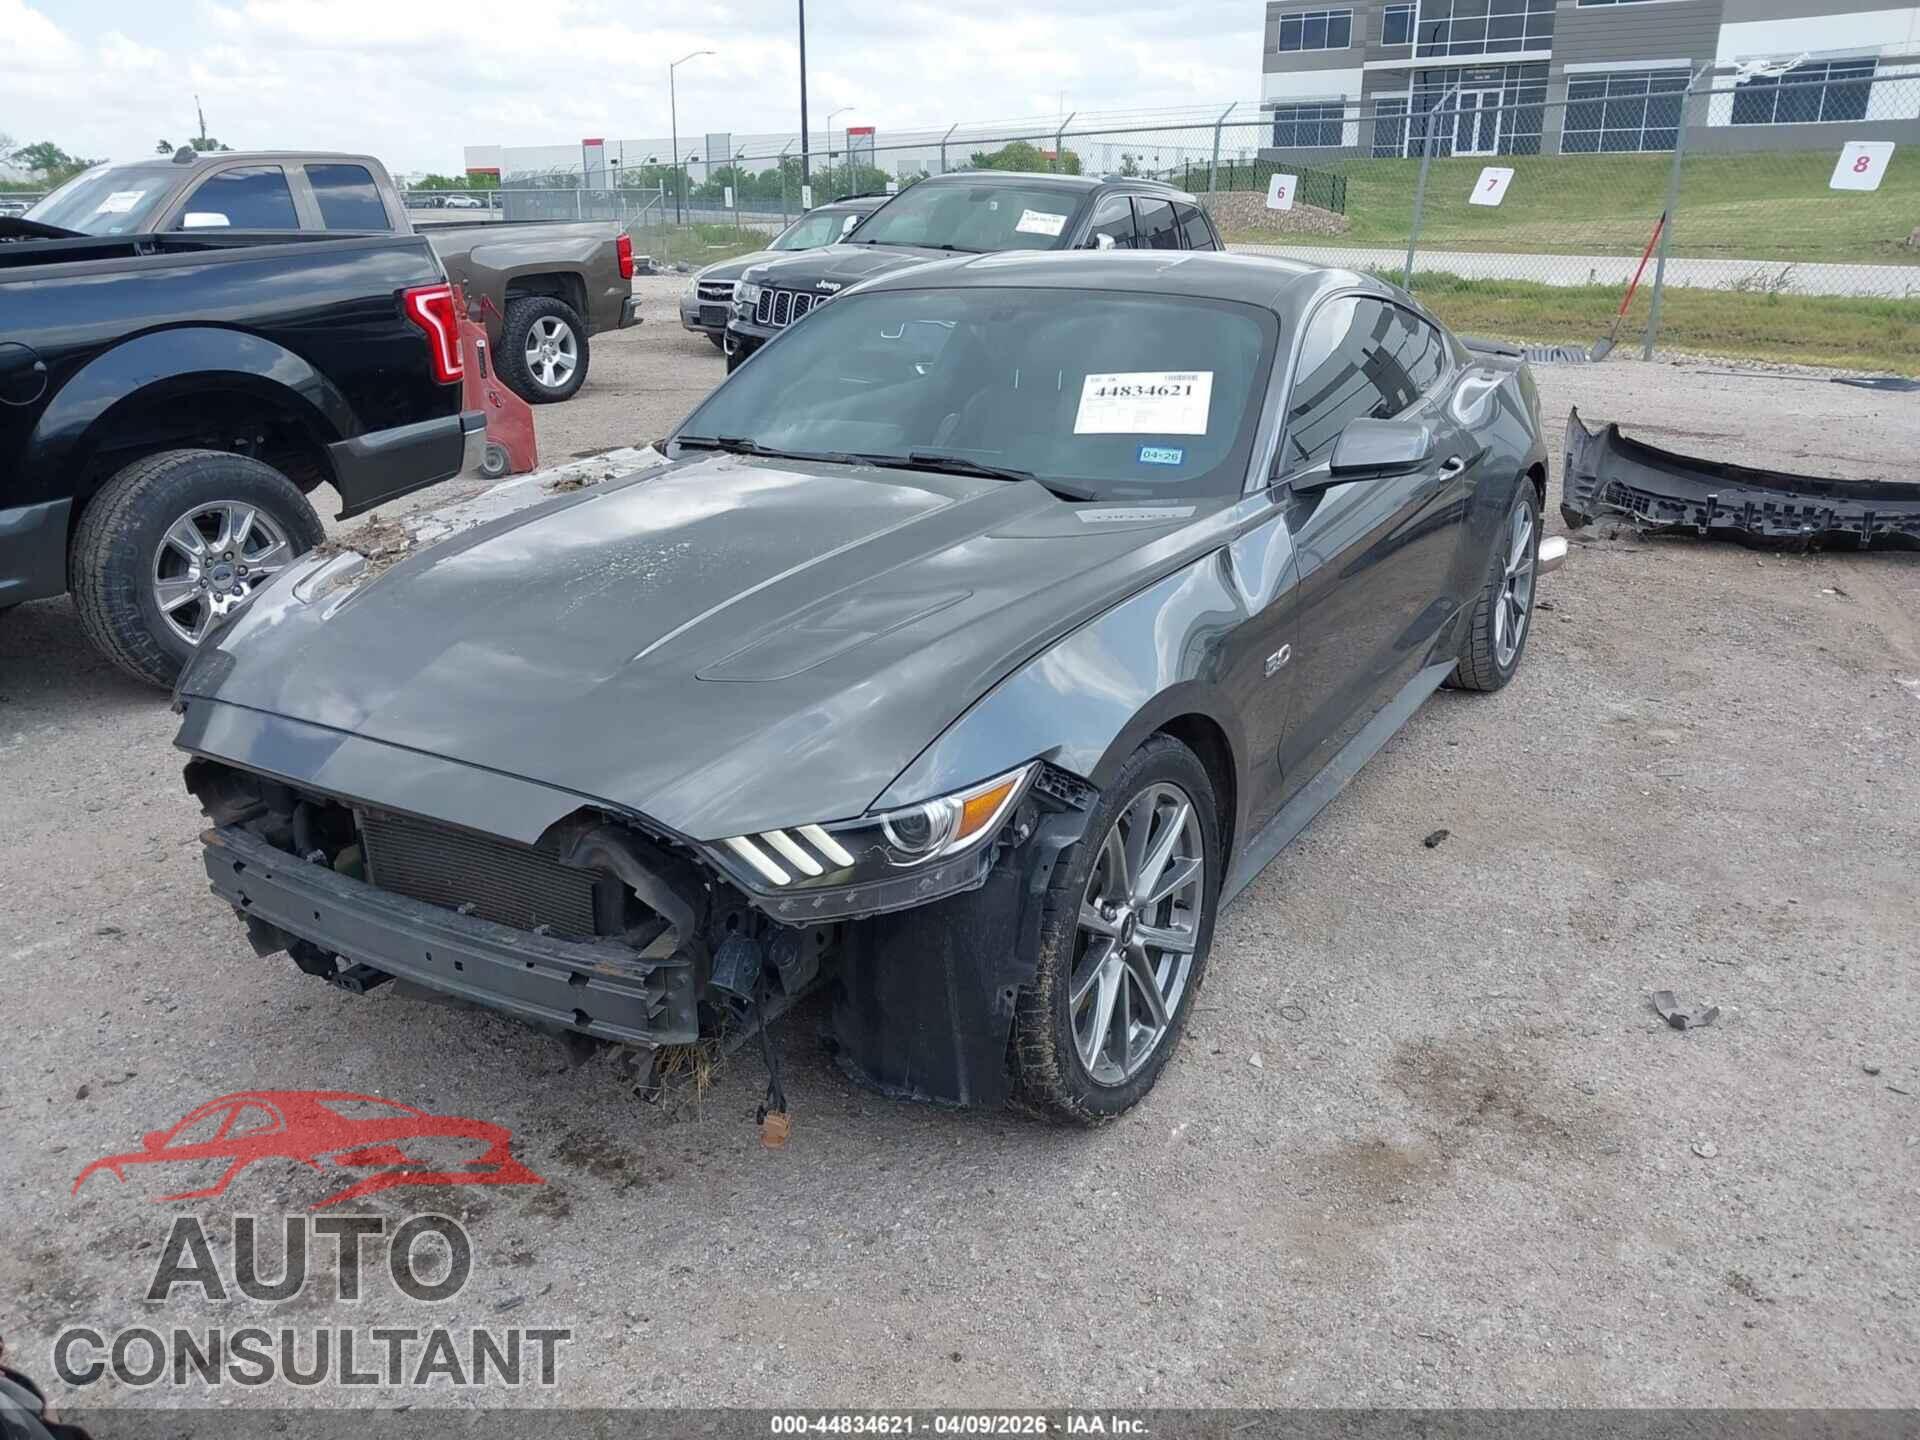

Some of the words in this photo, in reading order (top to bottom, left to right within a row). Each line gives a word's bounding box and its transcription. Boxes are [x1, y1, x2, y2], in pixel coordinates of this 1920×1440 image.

[1853, 155, 1871, 173] 8
[1486, 178, 1498, 192] 7
[1276, 186, 1286, 200] 6
[815, 279, 841, 292] Jeep
[1095, 384, 1192, 397] 44834621
[1142, 450, 1179, 461] 04-26
